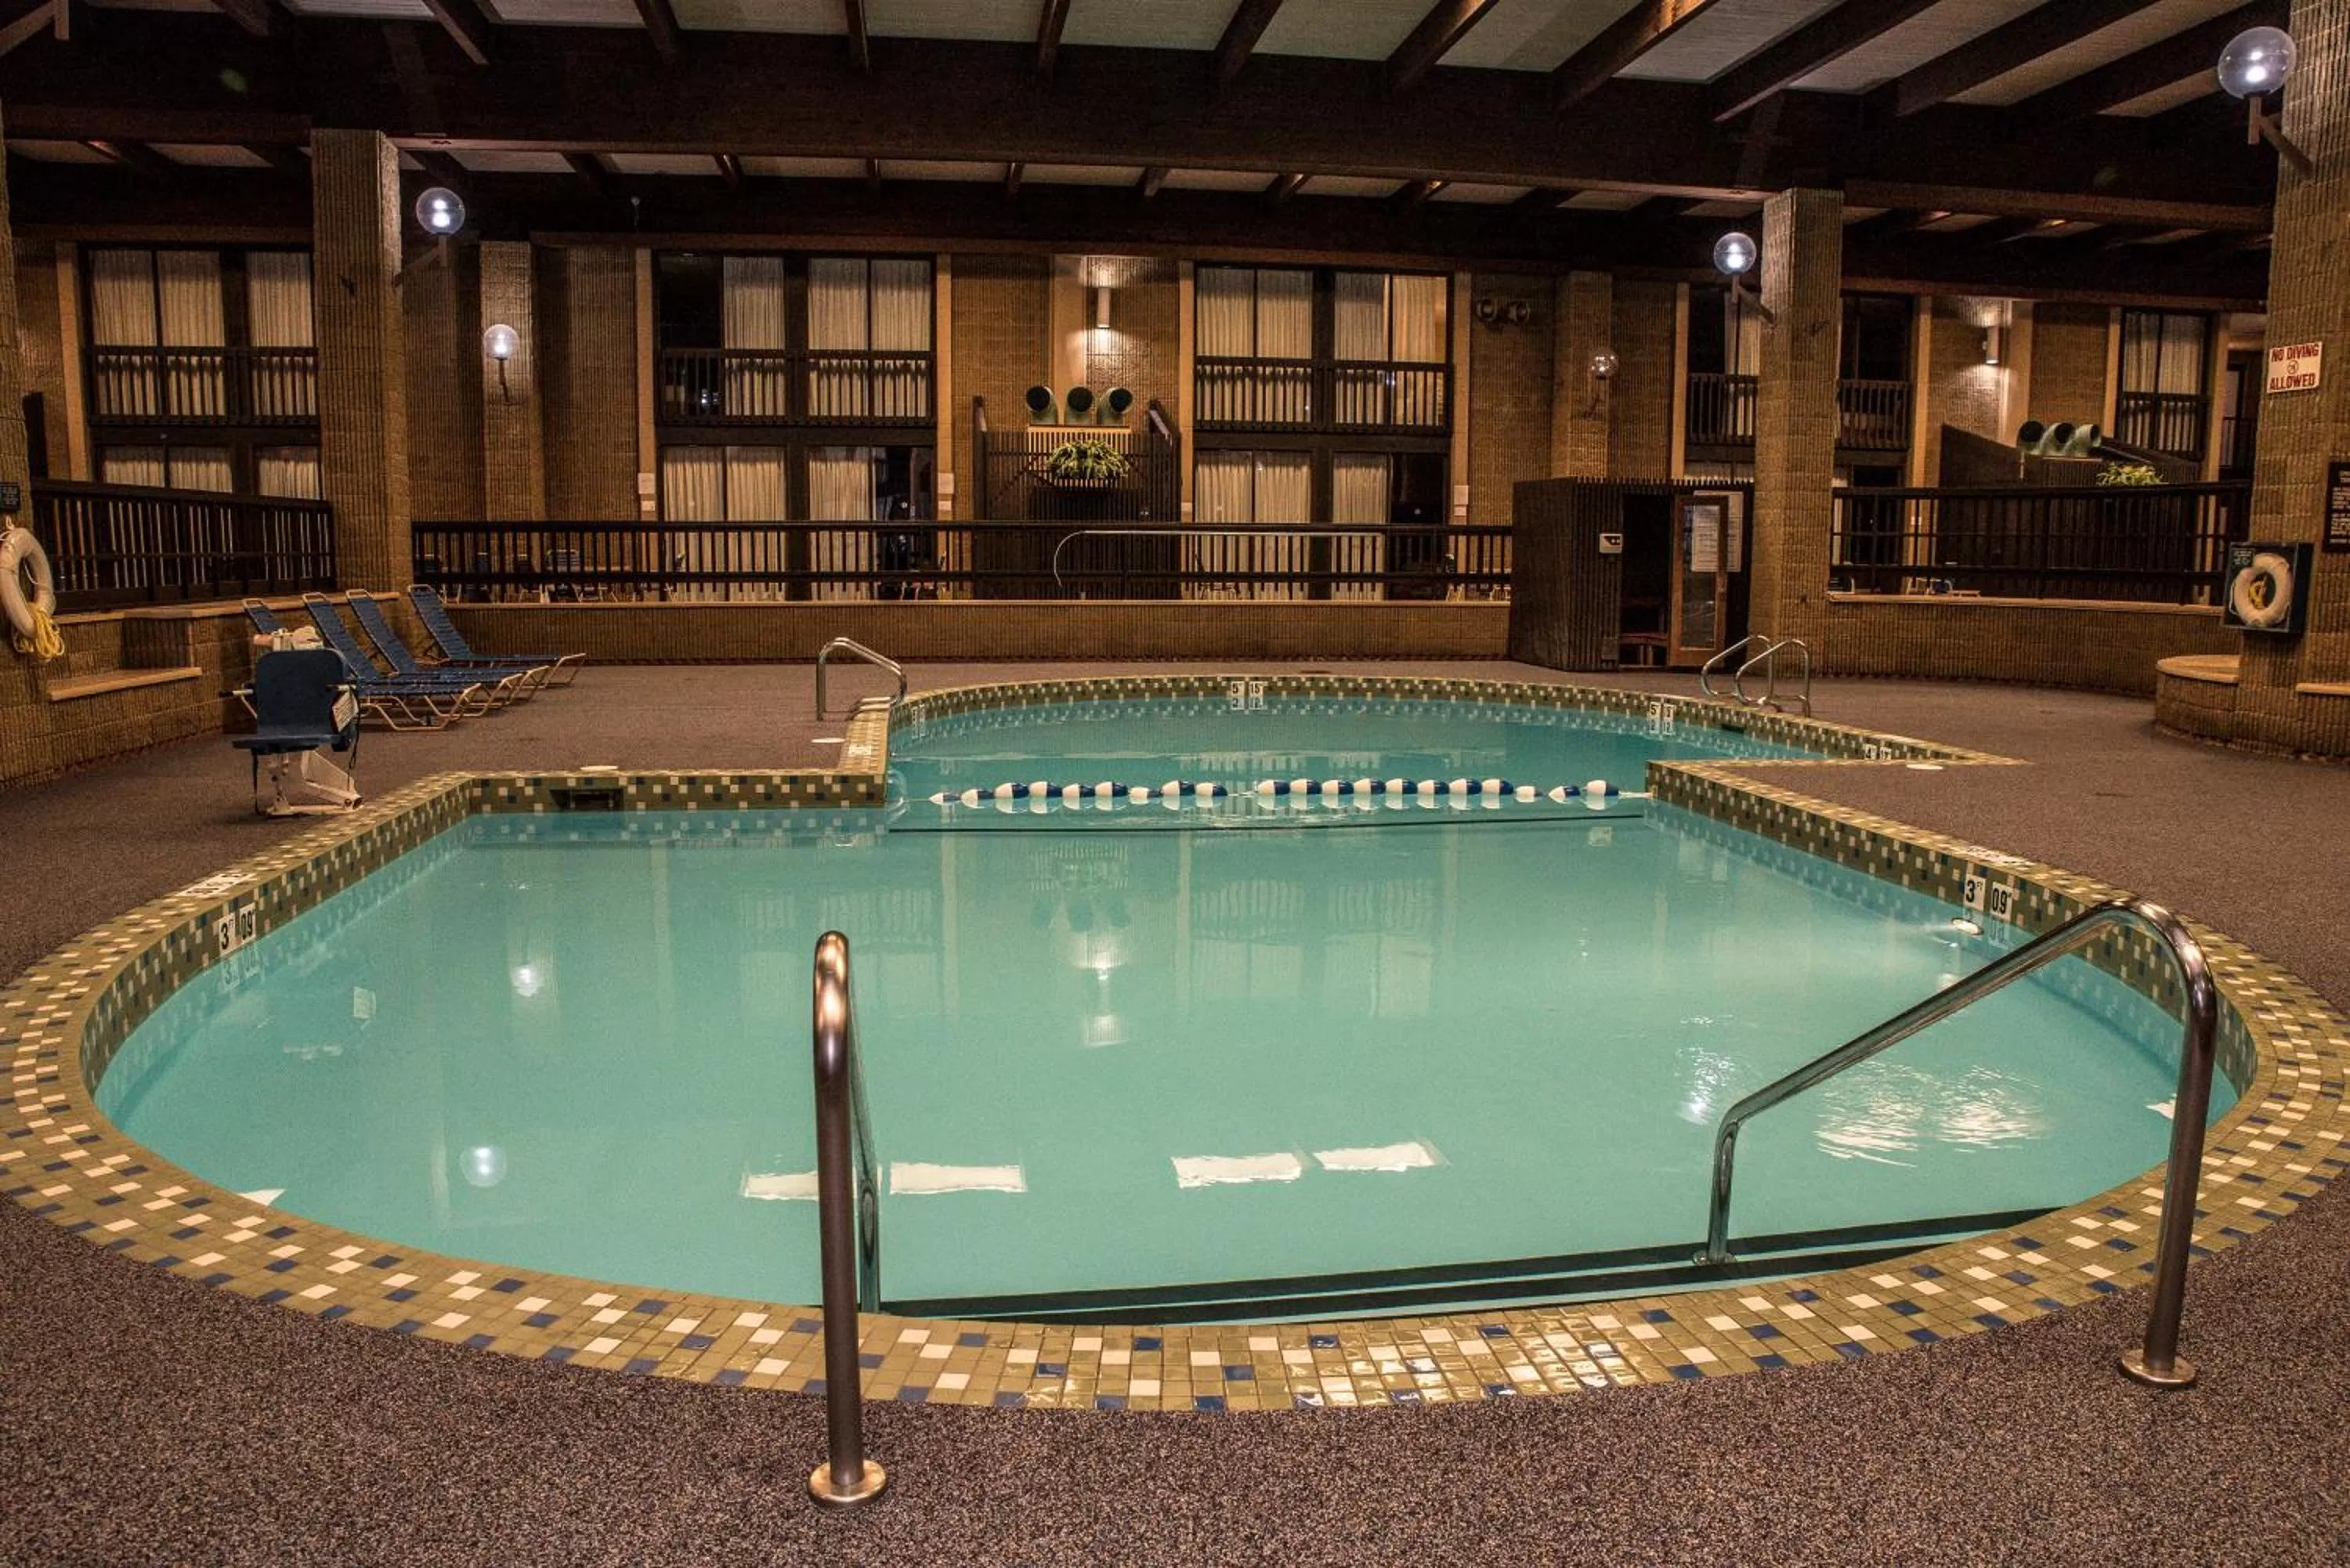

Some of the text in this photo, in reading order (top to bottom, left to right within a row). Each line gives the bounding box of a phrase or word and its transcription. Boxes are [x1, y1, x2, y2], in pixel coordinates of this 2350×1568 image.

[2272, 345, 2319, 363] NO DIVING
[2269, 373, 2316, 390] ALLOWED
[1965, 880, 1976, 903] 3
[1992, 887, 2008, 915] 09
[221, 922, 230, 950] 3
[240, 909, 253, 940] 09
